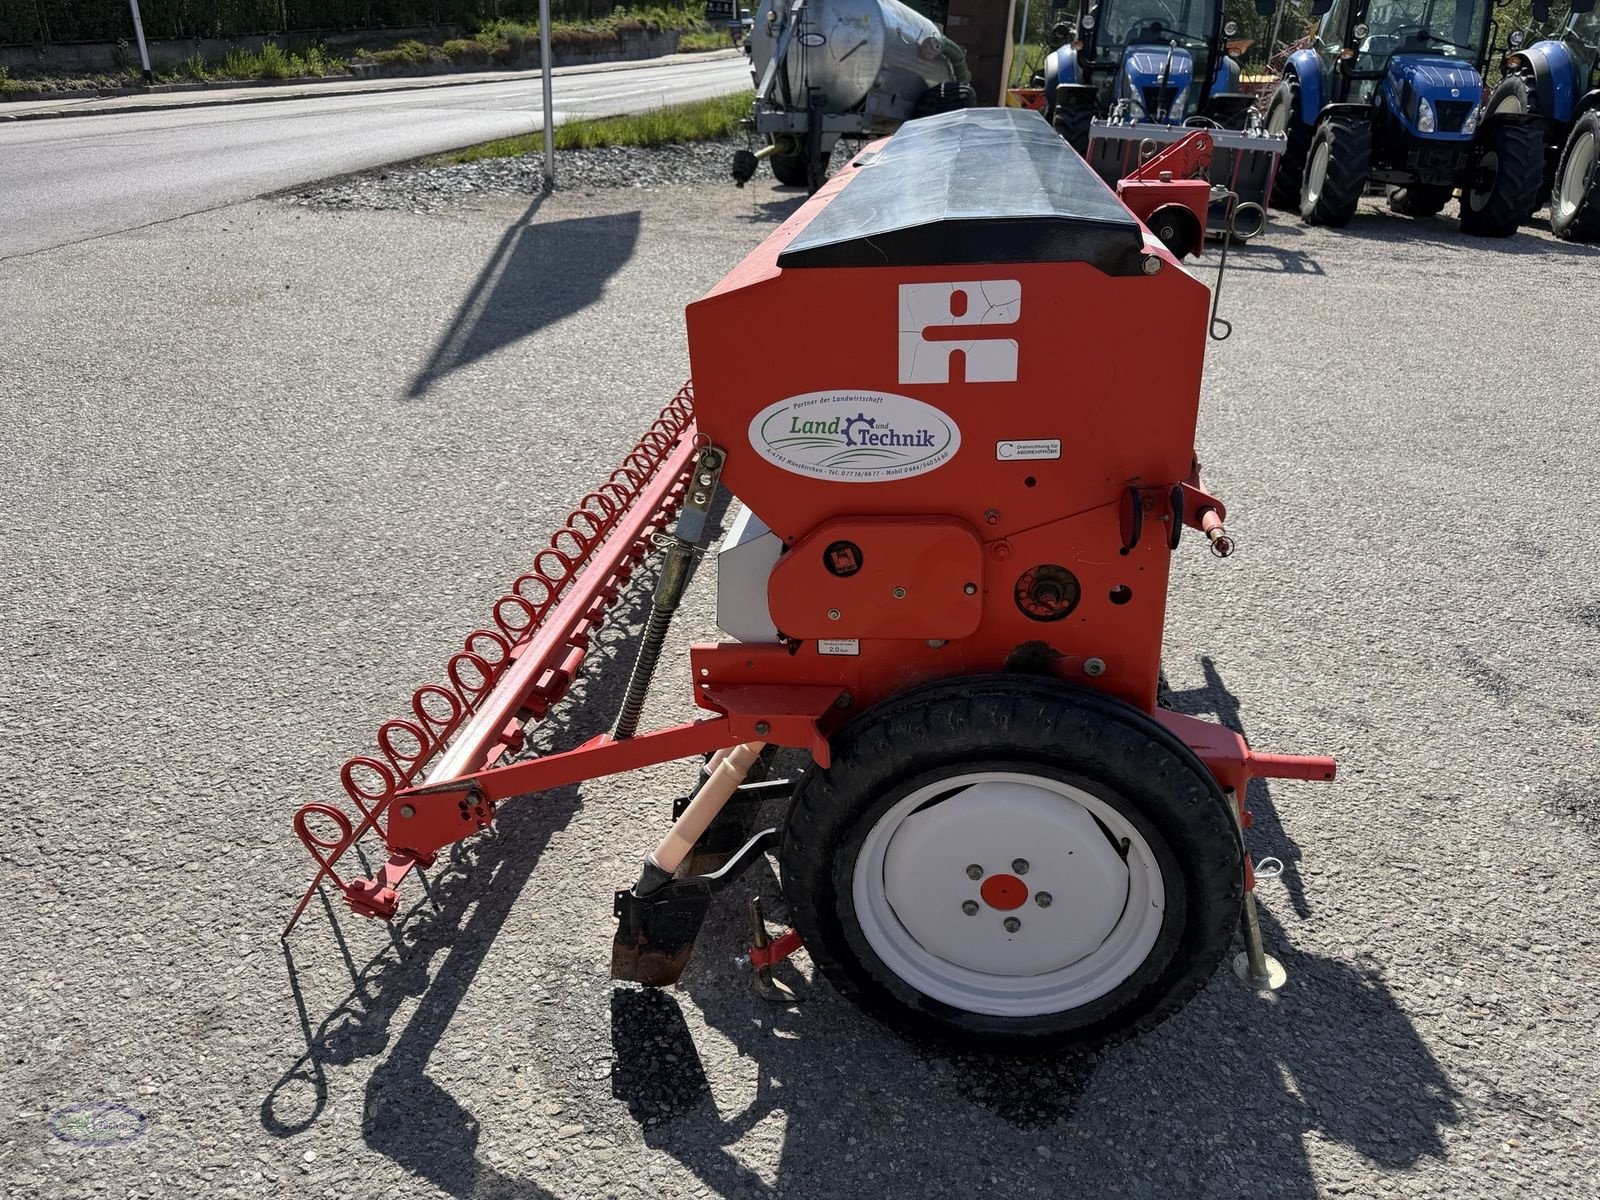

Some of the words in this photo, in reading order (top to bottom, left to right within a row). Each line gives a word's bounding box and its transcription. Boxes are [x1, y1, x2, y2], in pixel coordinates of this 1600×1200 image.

[793, 399, 817, 409] Partner
[832, 395, 883, 404] Landwirtschaft
[789, 416, 841, 435] Land
[875, 422, 889, 430] und
[858, 429, 935, 447] Technik
[886, 468, 903, 476] Mobil
